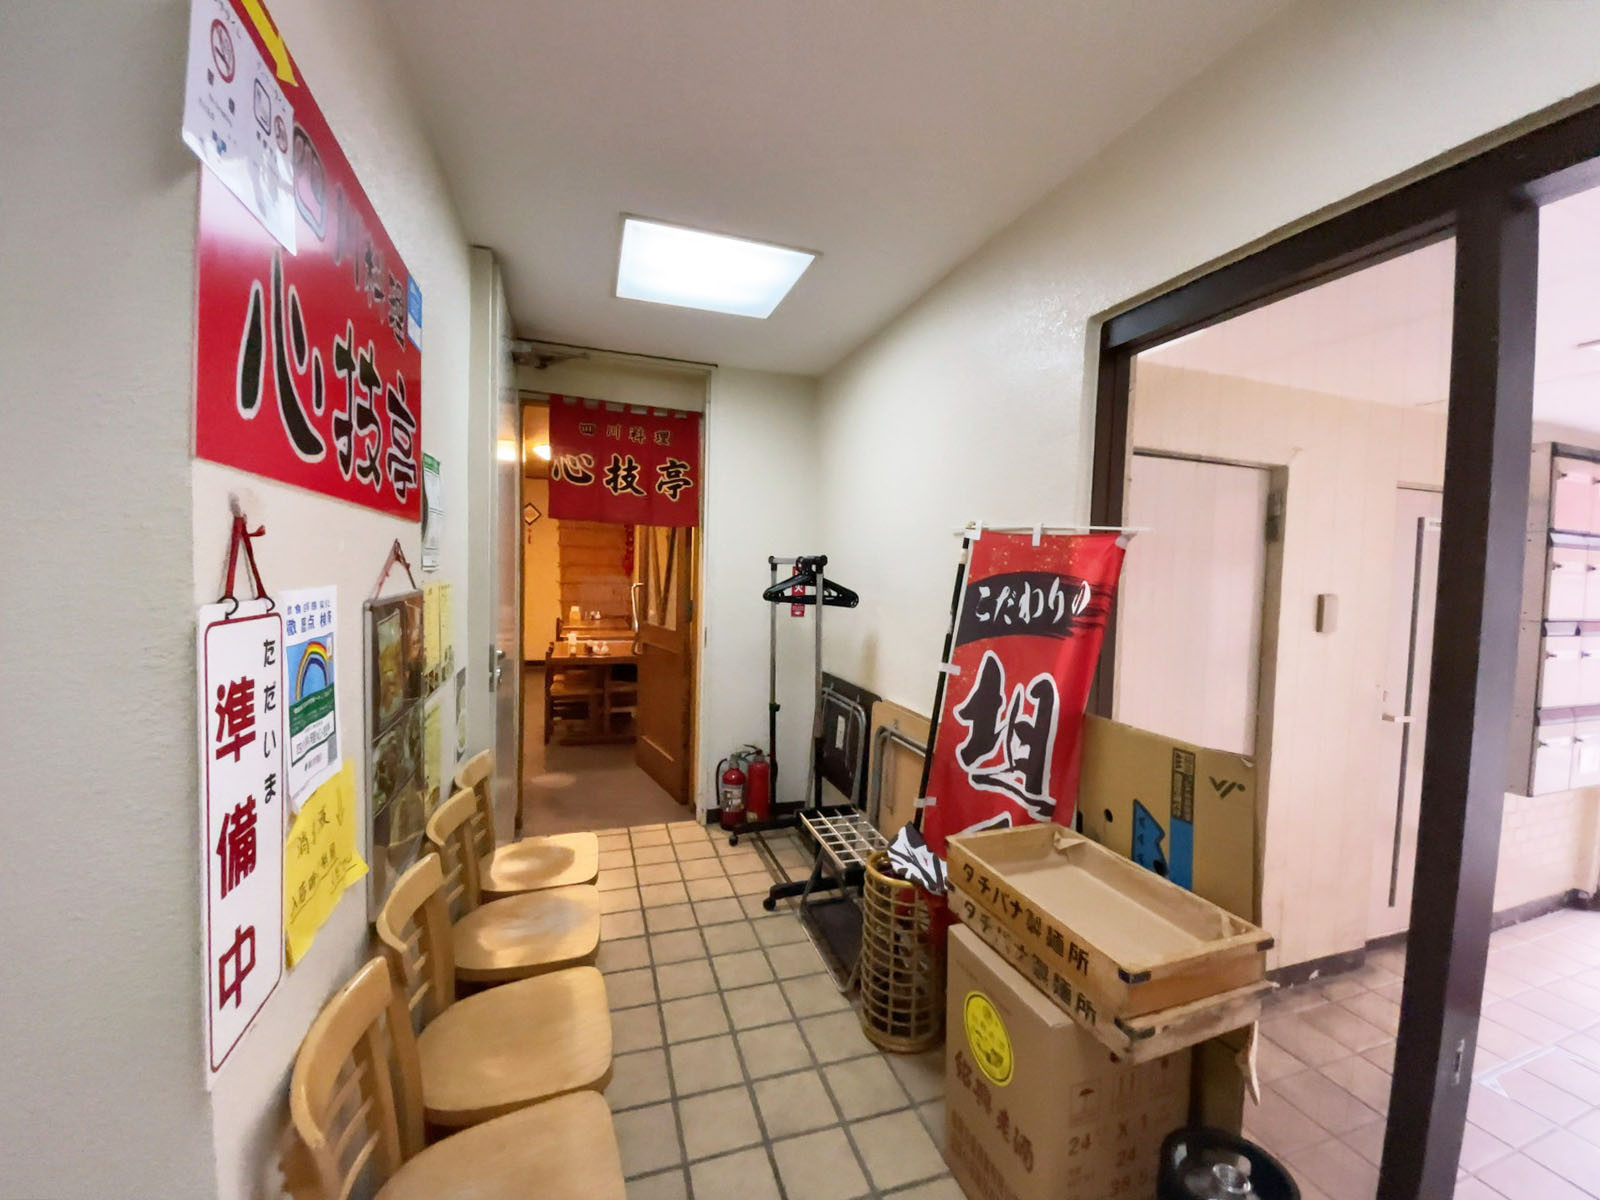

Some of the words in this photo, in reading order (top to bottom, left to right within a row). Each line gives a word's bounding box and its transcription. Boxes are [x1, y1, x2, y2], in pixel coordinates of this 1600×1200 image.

[236, 246, 417, 504] 心技亭
[552, 452, 694, 502] 心技亭
[579, 422, 671, 446] 四川料理
[975, 576, 1091, 625] こだわりの
[263, 639, 277, 804] ただいま
[215, 675, 258, 1011] 準備中
